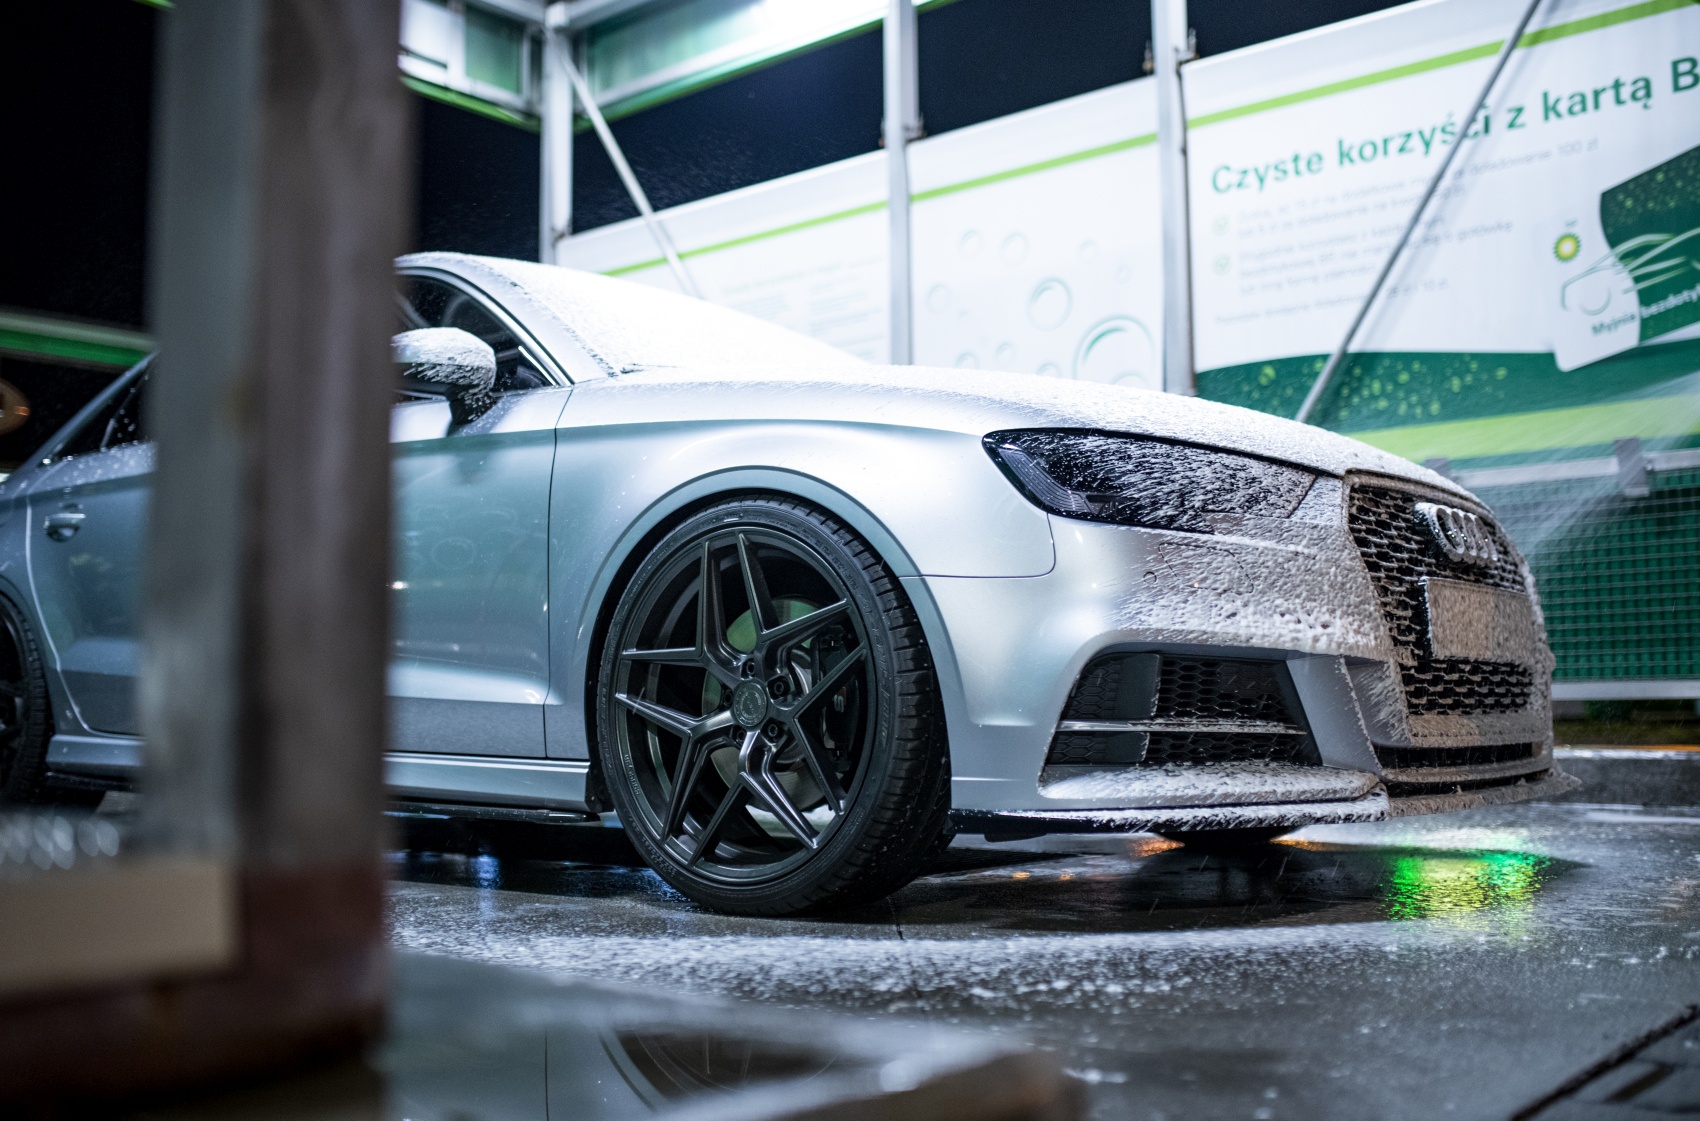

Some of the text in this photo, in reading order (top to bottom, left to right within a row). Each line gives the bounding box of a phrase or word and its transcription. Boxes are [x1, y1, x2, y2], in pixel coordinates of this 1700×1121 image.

[1212, 152, 1324, 194] Czyste
[1506, 104, 1526, 129] z
[1543, 74, 1652, 121] kartą
[1672, 57, 1700, 92] B
